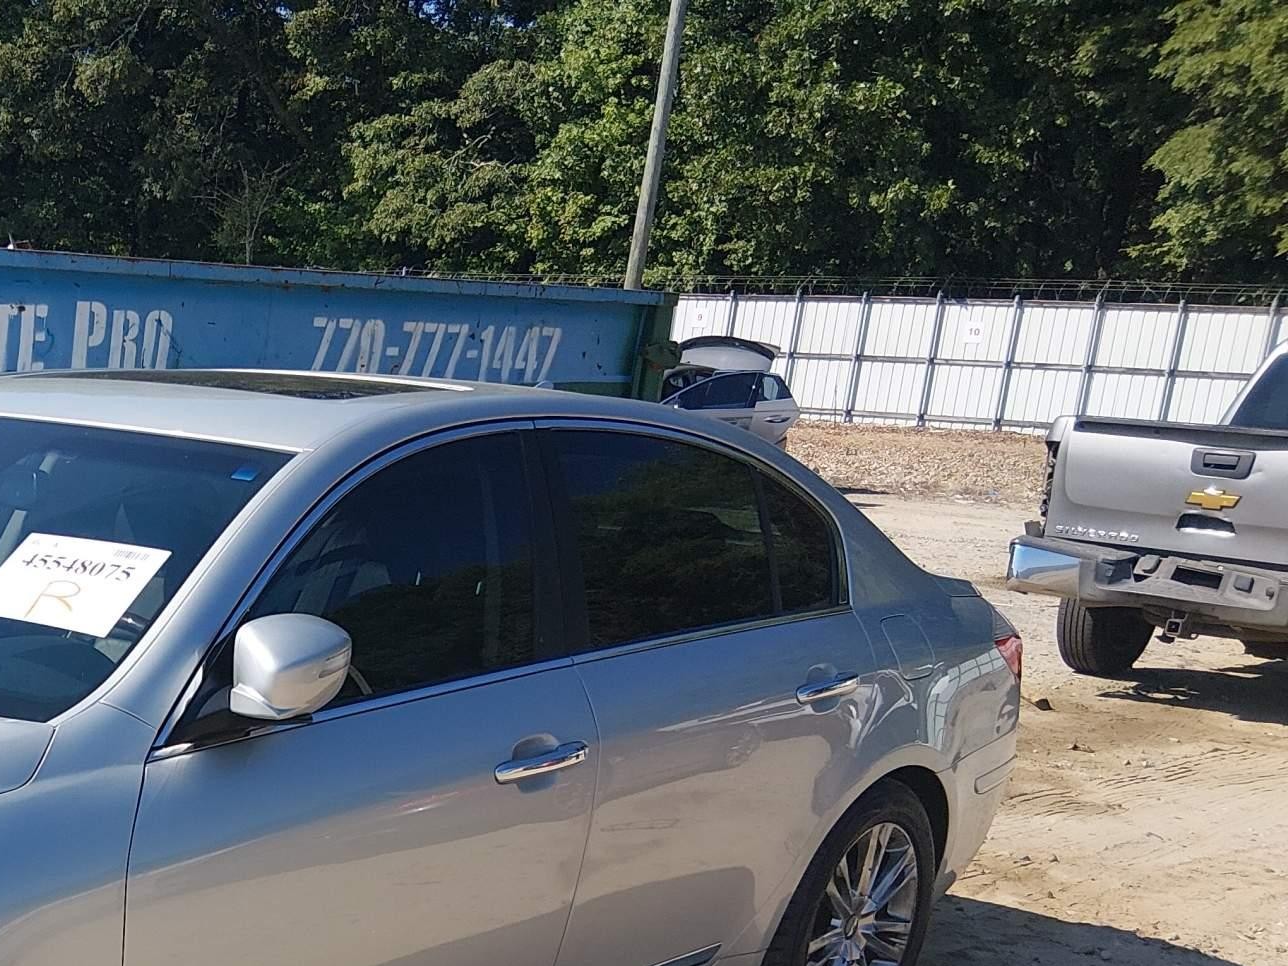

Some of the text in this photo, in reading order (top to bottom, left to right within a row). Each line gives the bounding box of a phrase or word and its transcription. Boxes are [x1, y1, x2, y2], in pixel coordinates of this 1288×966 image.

[71, 300, 173, 370] PRO
[968, 327, 980, 336] 10
[311, 316, 562, 383] 770-777-1447
[1055, 524, 1139, 542] SILVERADO
[22, 552, 136, 582] 45548075
[24, 580, 81, 618] R
